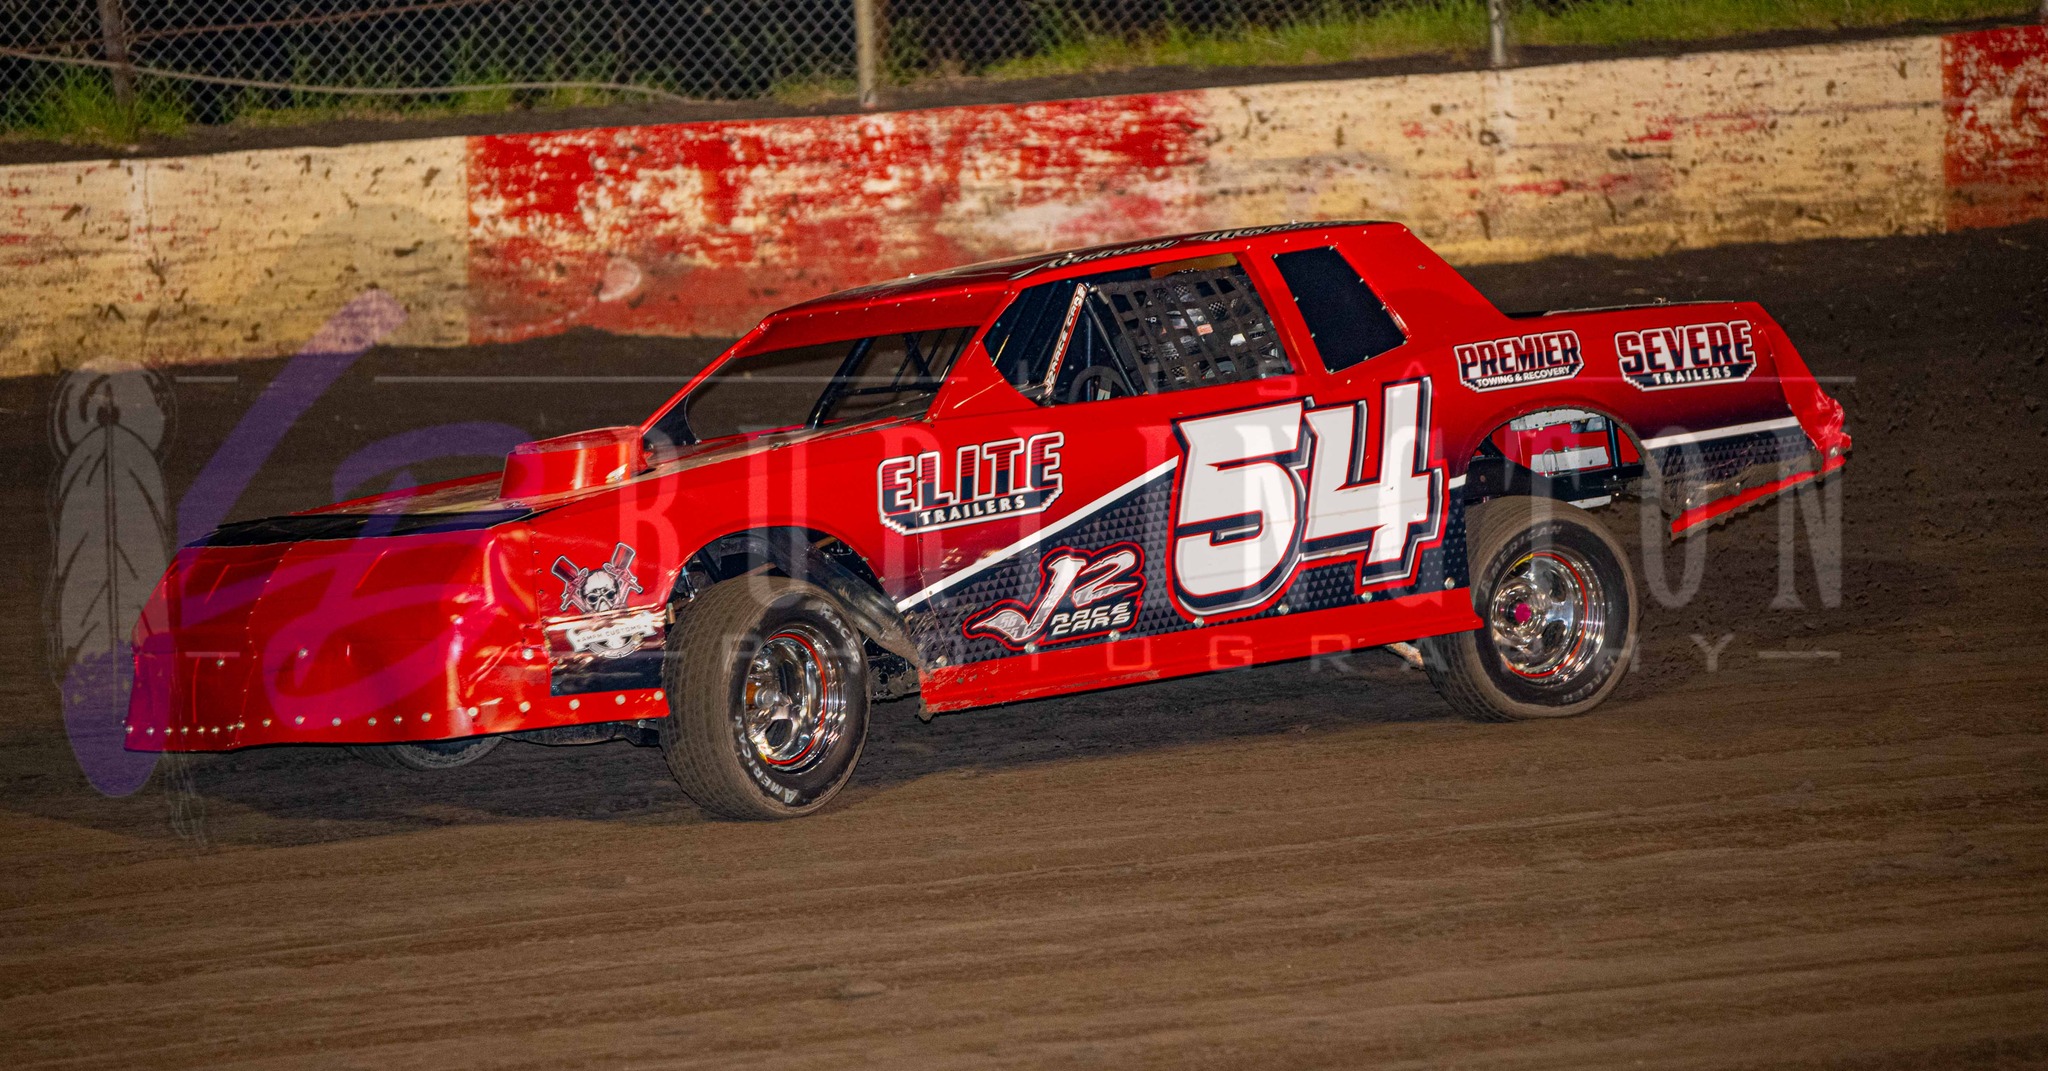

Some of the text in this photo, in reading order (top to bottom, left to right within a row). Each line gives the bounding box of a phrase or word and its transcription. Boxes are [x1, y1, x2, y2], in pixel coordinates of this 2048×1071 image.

[1050, 330, 1069, 373] RACE
[1456, 331, 1581, 379] PREMIER
[1616, 321, 1753, 374] SEVERE
[1476, 373, 1515, 388] TOWING
[1523, 366, 1571, 382] RECOVERY
[1652, 366, 1732, 386] TRAILERS
[880, 434, 1064, 513] ELITE
[1174, 380, 1442, 613] 54
[919, 495, 1026, 526] TRAILERS
[972, 550, 1139, 641] J2
[1050, 601, 1131, 626] RACE
[819, 602, 861, 664] RACER
[1051, 612, 1131, 636] CARS
[734, 715, 799, 804] AMERICAN
